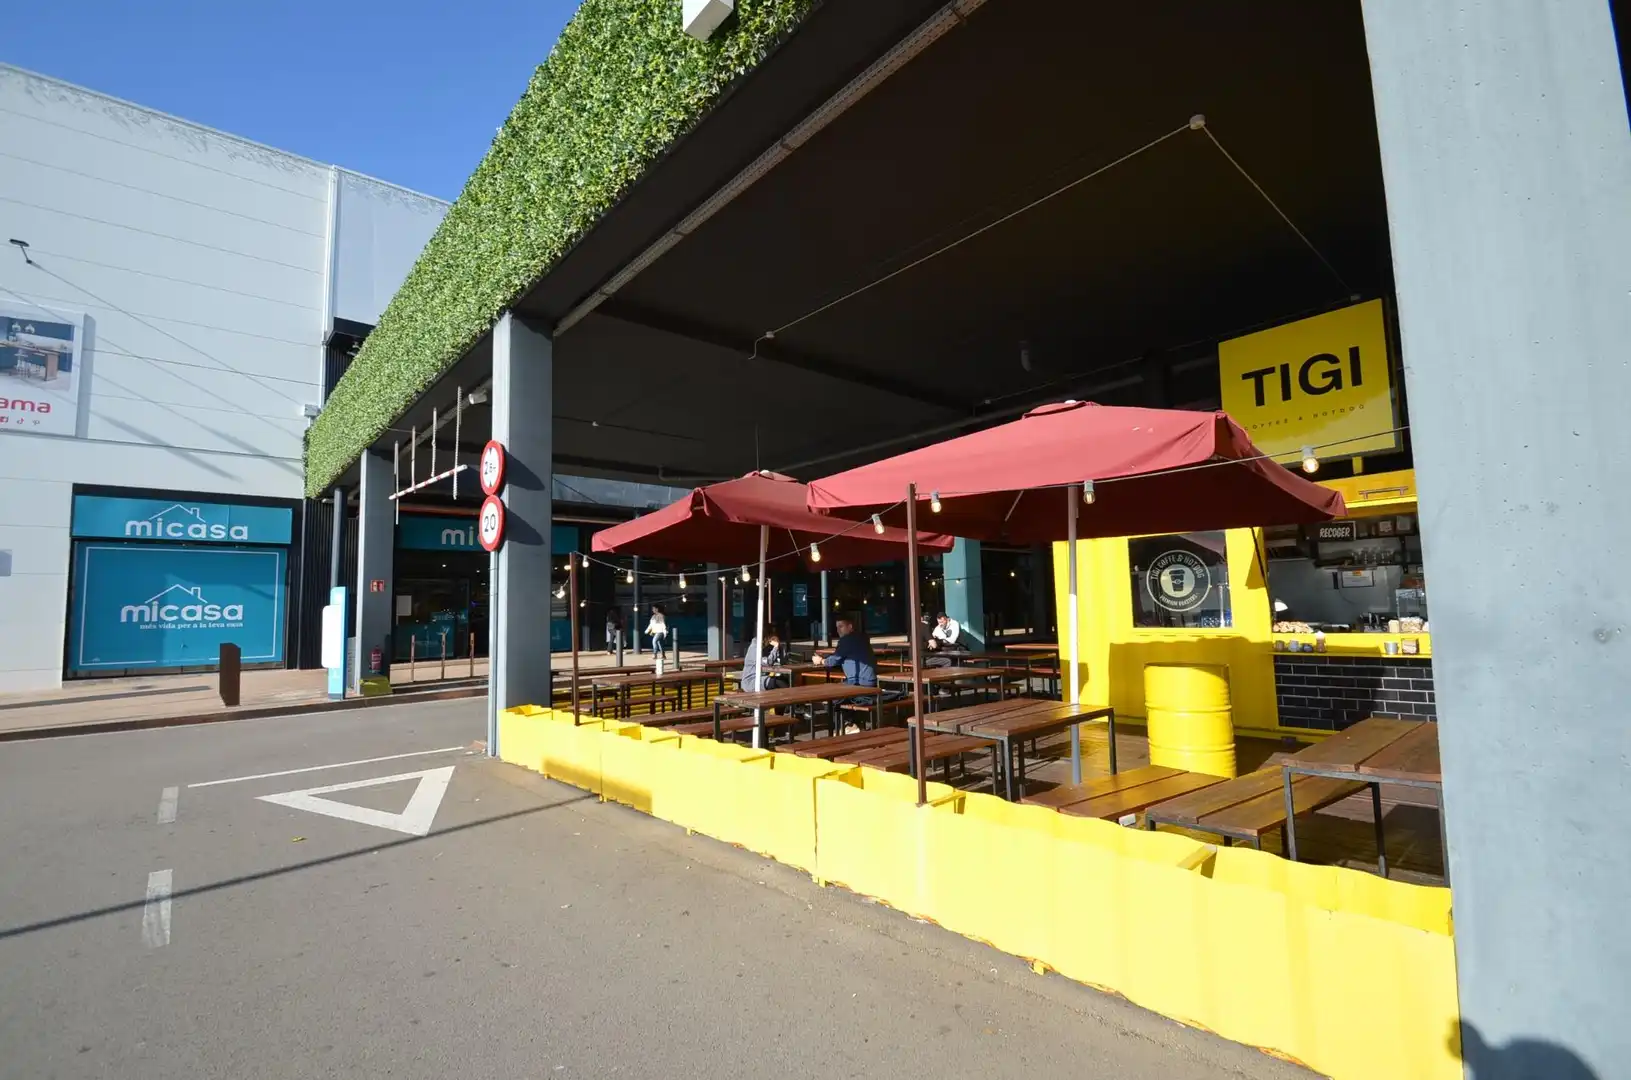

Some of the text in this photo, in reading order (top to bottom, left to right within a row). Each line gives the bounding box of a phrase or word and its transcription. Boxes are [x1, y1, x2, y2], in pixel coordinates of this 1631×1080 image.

[1241, 346, 1363, 407] TIGI
[125, 518, 248, 540] micasa
[483, 513, 496, 533] 20
[1320, 527, 1351, 538] RECOGER
[120, 600, 244, 622] micasa
[177, 622, 191, 630] per
